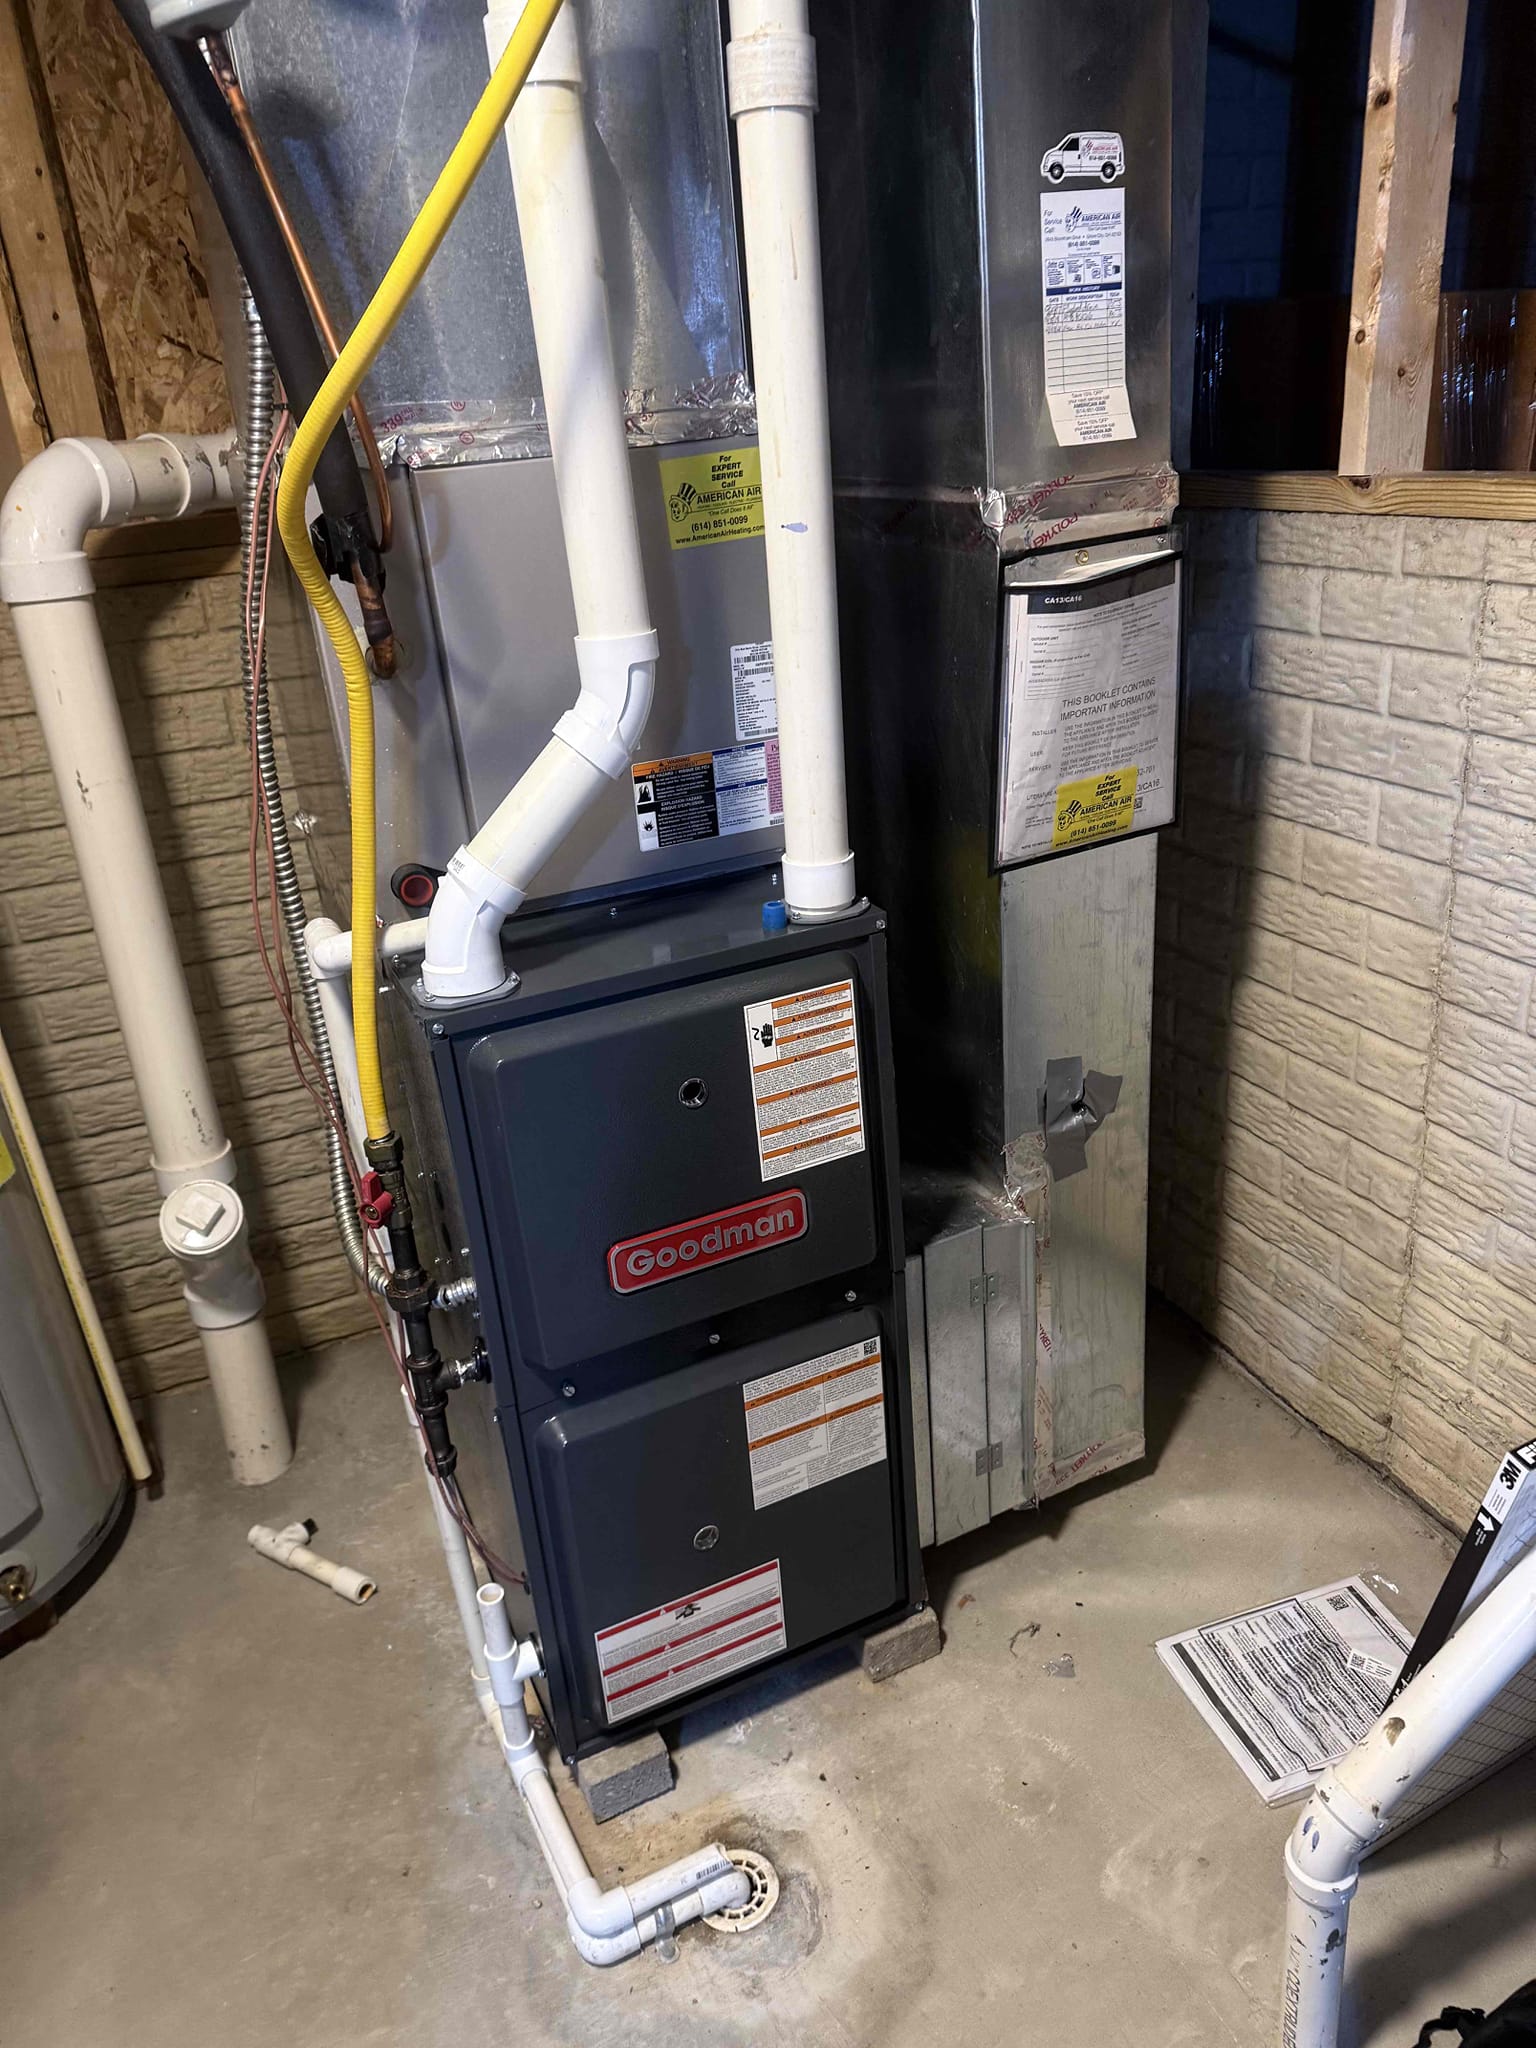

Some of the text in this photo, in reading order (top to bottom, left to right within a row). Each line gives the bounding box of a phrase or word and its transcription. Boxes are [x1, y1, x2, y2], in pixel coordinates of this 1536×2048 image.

[712, 462, 742, 472] EXPERT
[720, 455, 732, 463] For
[712, 470, 744, 482] SERVICE
[722, 480, 736, 488] Call
[697, 488, 744, 504] AMERICAN
[747, 486, 761, 496] AIR
[692, 516, 748, 533] (614) 851-0099
[1062, 677, 1156, 708] THIS BOOKLET CONTAINS
[1060, 704, 1108, 721] IMPORTANT
[1109, 689, 1156, 710] INFORMATION
[1096, 778, 1121, 790] EXPERT
[1096, 785, 1121, 797] SERVICE
[1079, 796, 1132, 816] AMERICAN AIR
[626, 1208, 794, 1276] Goodman
[1500, 1458, 1522, 1490] 3M
